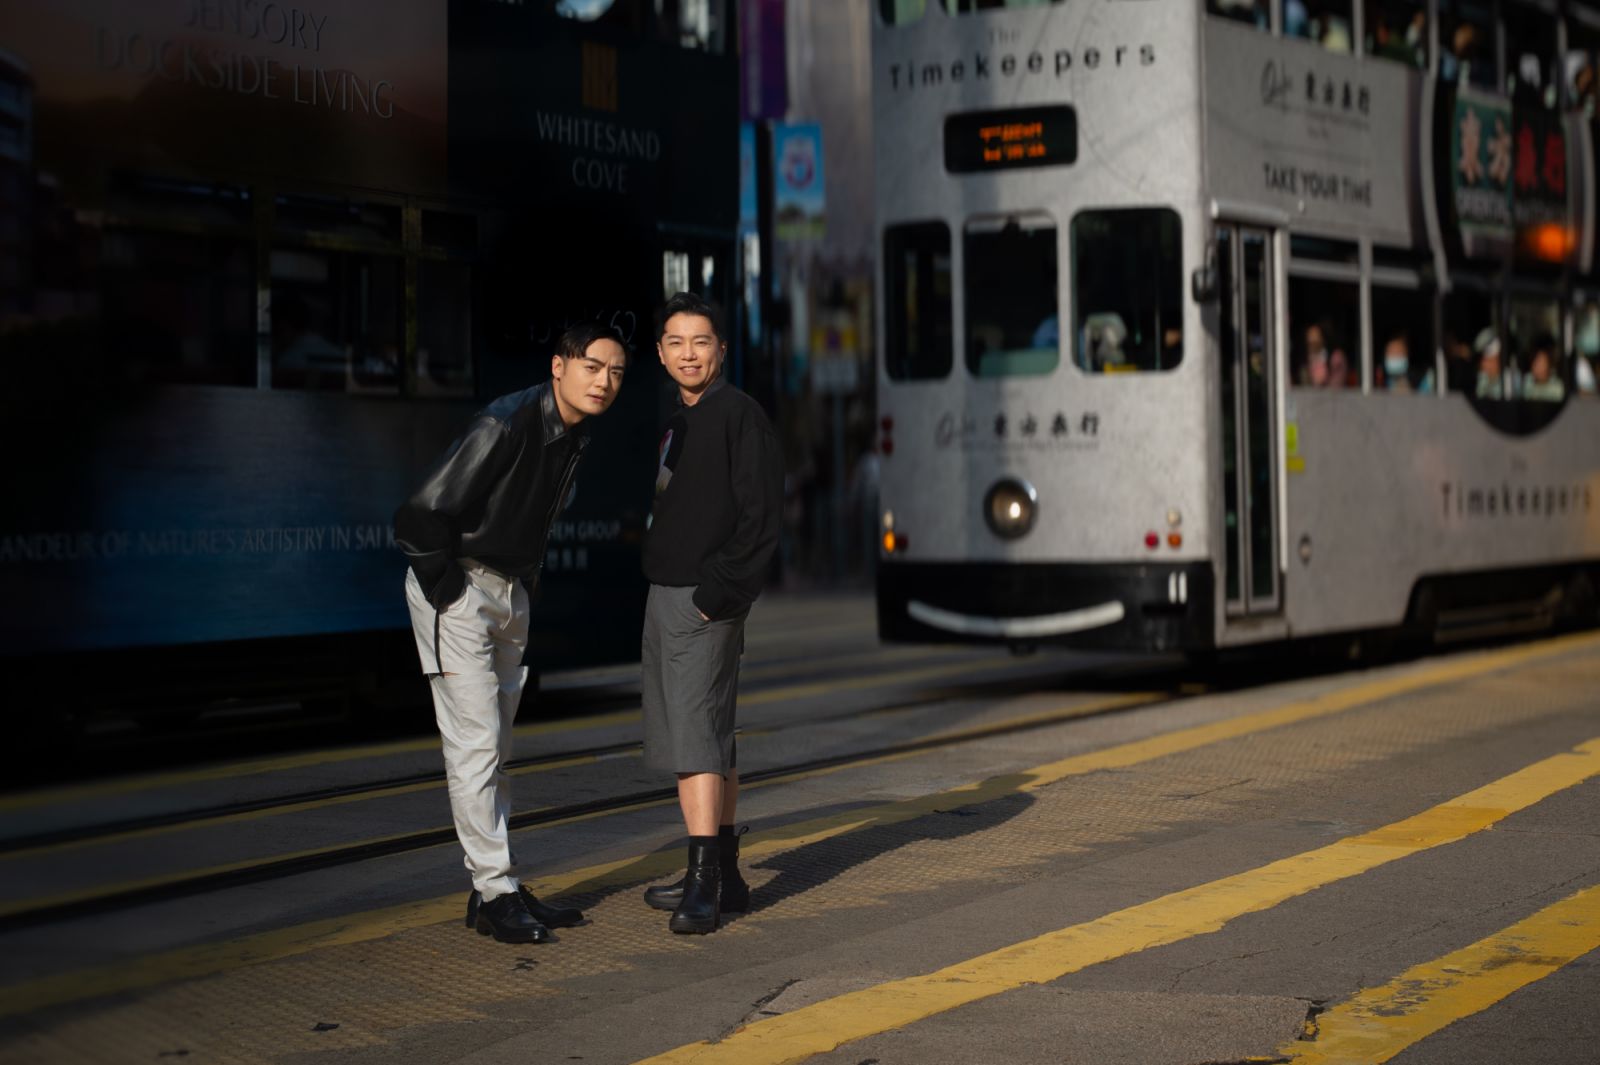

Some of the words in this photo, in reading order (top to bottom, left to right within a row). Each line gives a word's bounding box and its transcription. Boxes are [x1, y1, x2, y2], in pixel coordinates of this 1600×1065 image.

[95, 27, 280, 99] DOCKSIDE
[293, 63, 394, 119] LIVING
[889, 44, 1156, 90] Timekeepers
[536, 109, 661, 162] WHITESAND
[572, 156, 629, 194] COVE
[1263, 162, 1297, 196] TAKE
[1301, 171, 1338, 200] YOUR
[1341, 175, 1371, 208] TIME
[1441, 481, 1592, 519] Timekeepers
[102, 529, 134, 559] OF
[241, 525, 326, 552] ARTISTRY
[330, 525, 350, 550] IN
[356, 524, 382, 550] SAI
